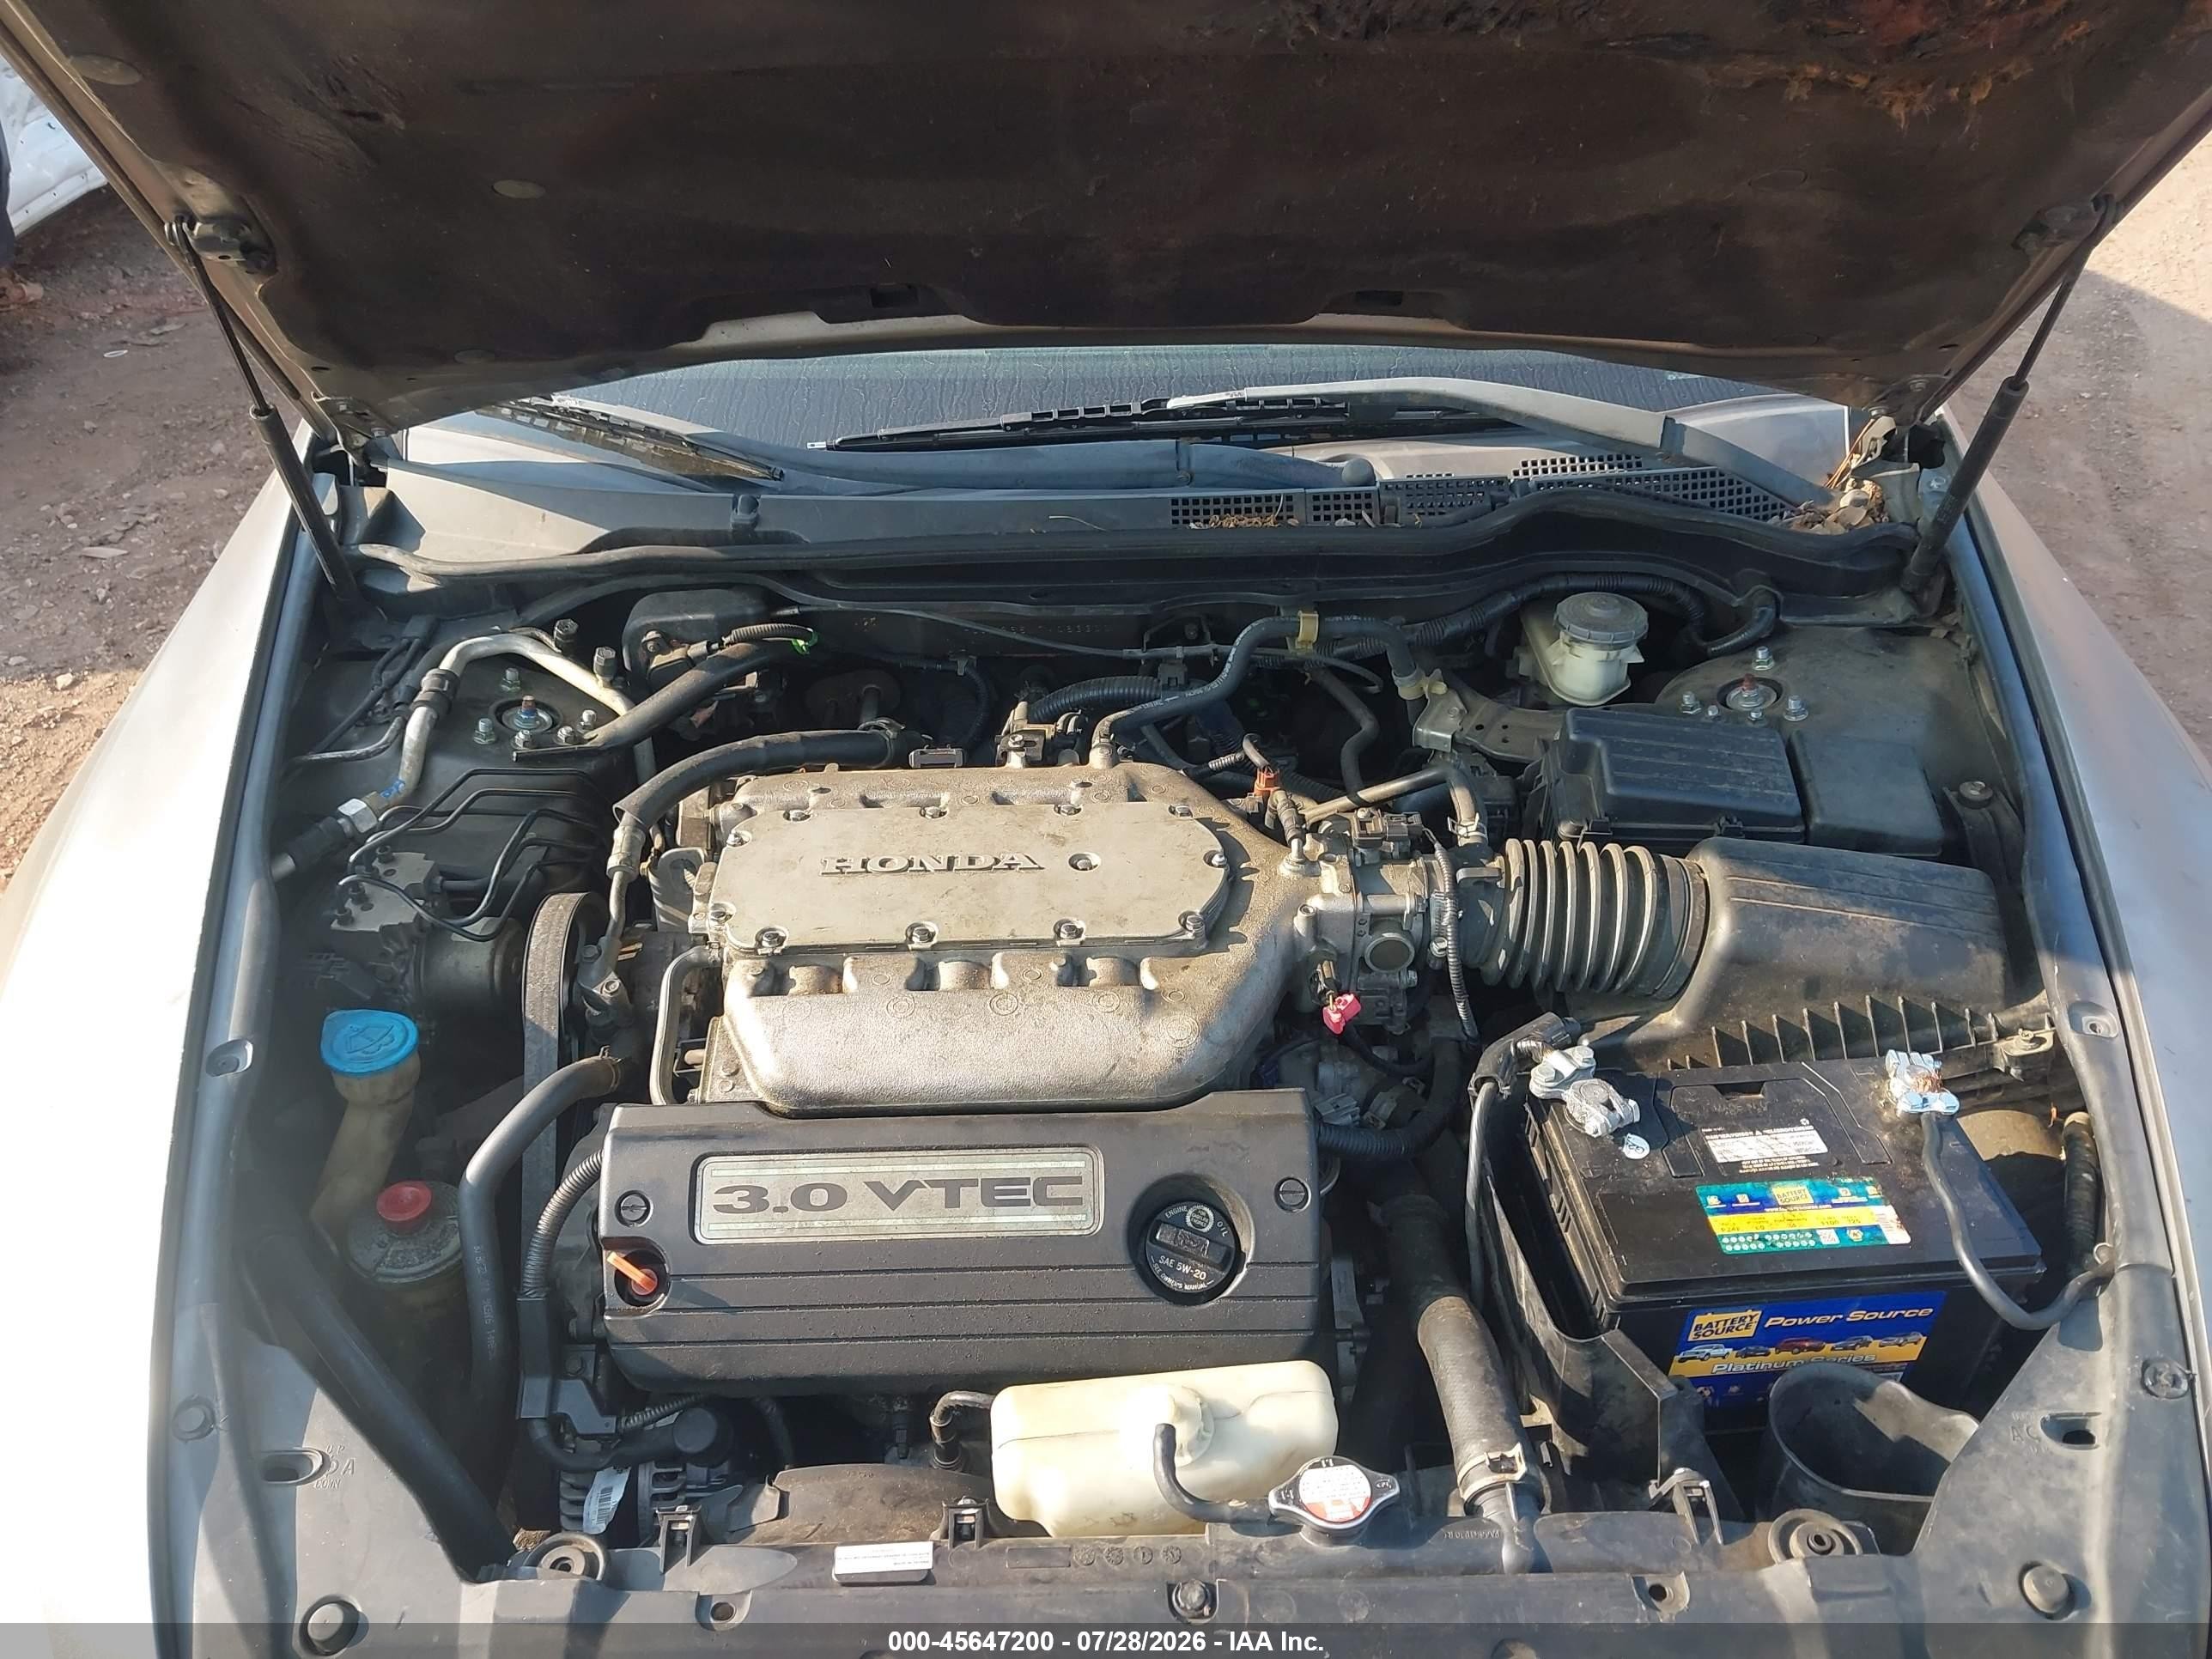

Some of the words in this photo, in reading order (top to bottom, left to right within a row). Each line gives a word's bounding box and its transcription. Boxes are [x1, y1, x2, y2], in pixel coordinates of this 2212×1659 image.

[820, 852, 1045, 875] HONDA
[713, 1182, 848, 1214] 3.0
[863, 1176, 1083, 1211] VTEC
[1164, 1206, 1188, 1218] ENGINE
[1217, 1220, 1230, 1237] OIL
[1152, 1262, 1163, 1274] SEE
[1160, 1273, 1183, 1289] OWNER'S
[1158, 1255, 1176, 1268] SAE
[1176, 1261, 1206, 1280] 5W-20
[1693, 1312, 1758, 1332] BATTERY
[1764, 1313, 1844, 1328] Power
[1846, 1308, 1934, 1322] Source
[1692, 1322, 1753, 1340] SOURCE
[1711, 1359, 1803, 1375] Platinum
